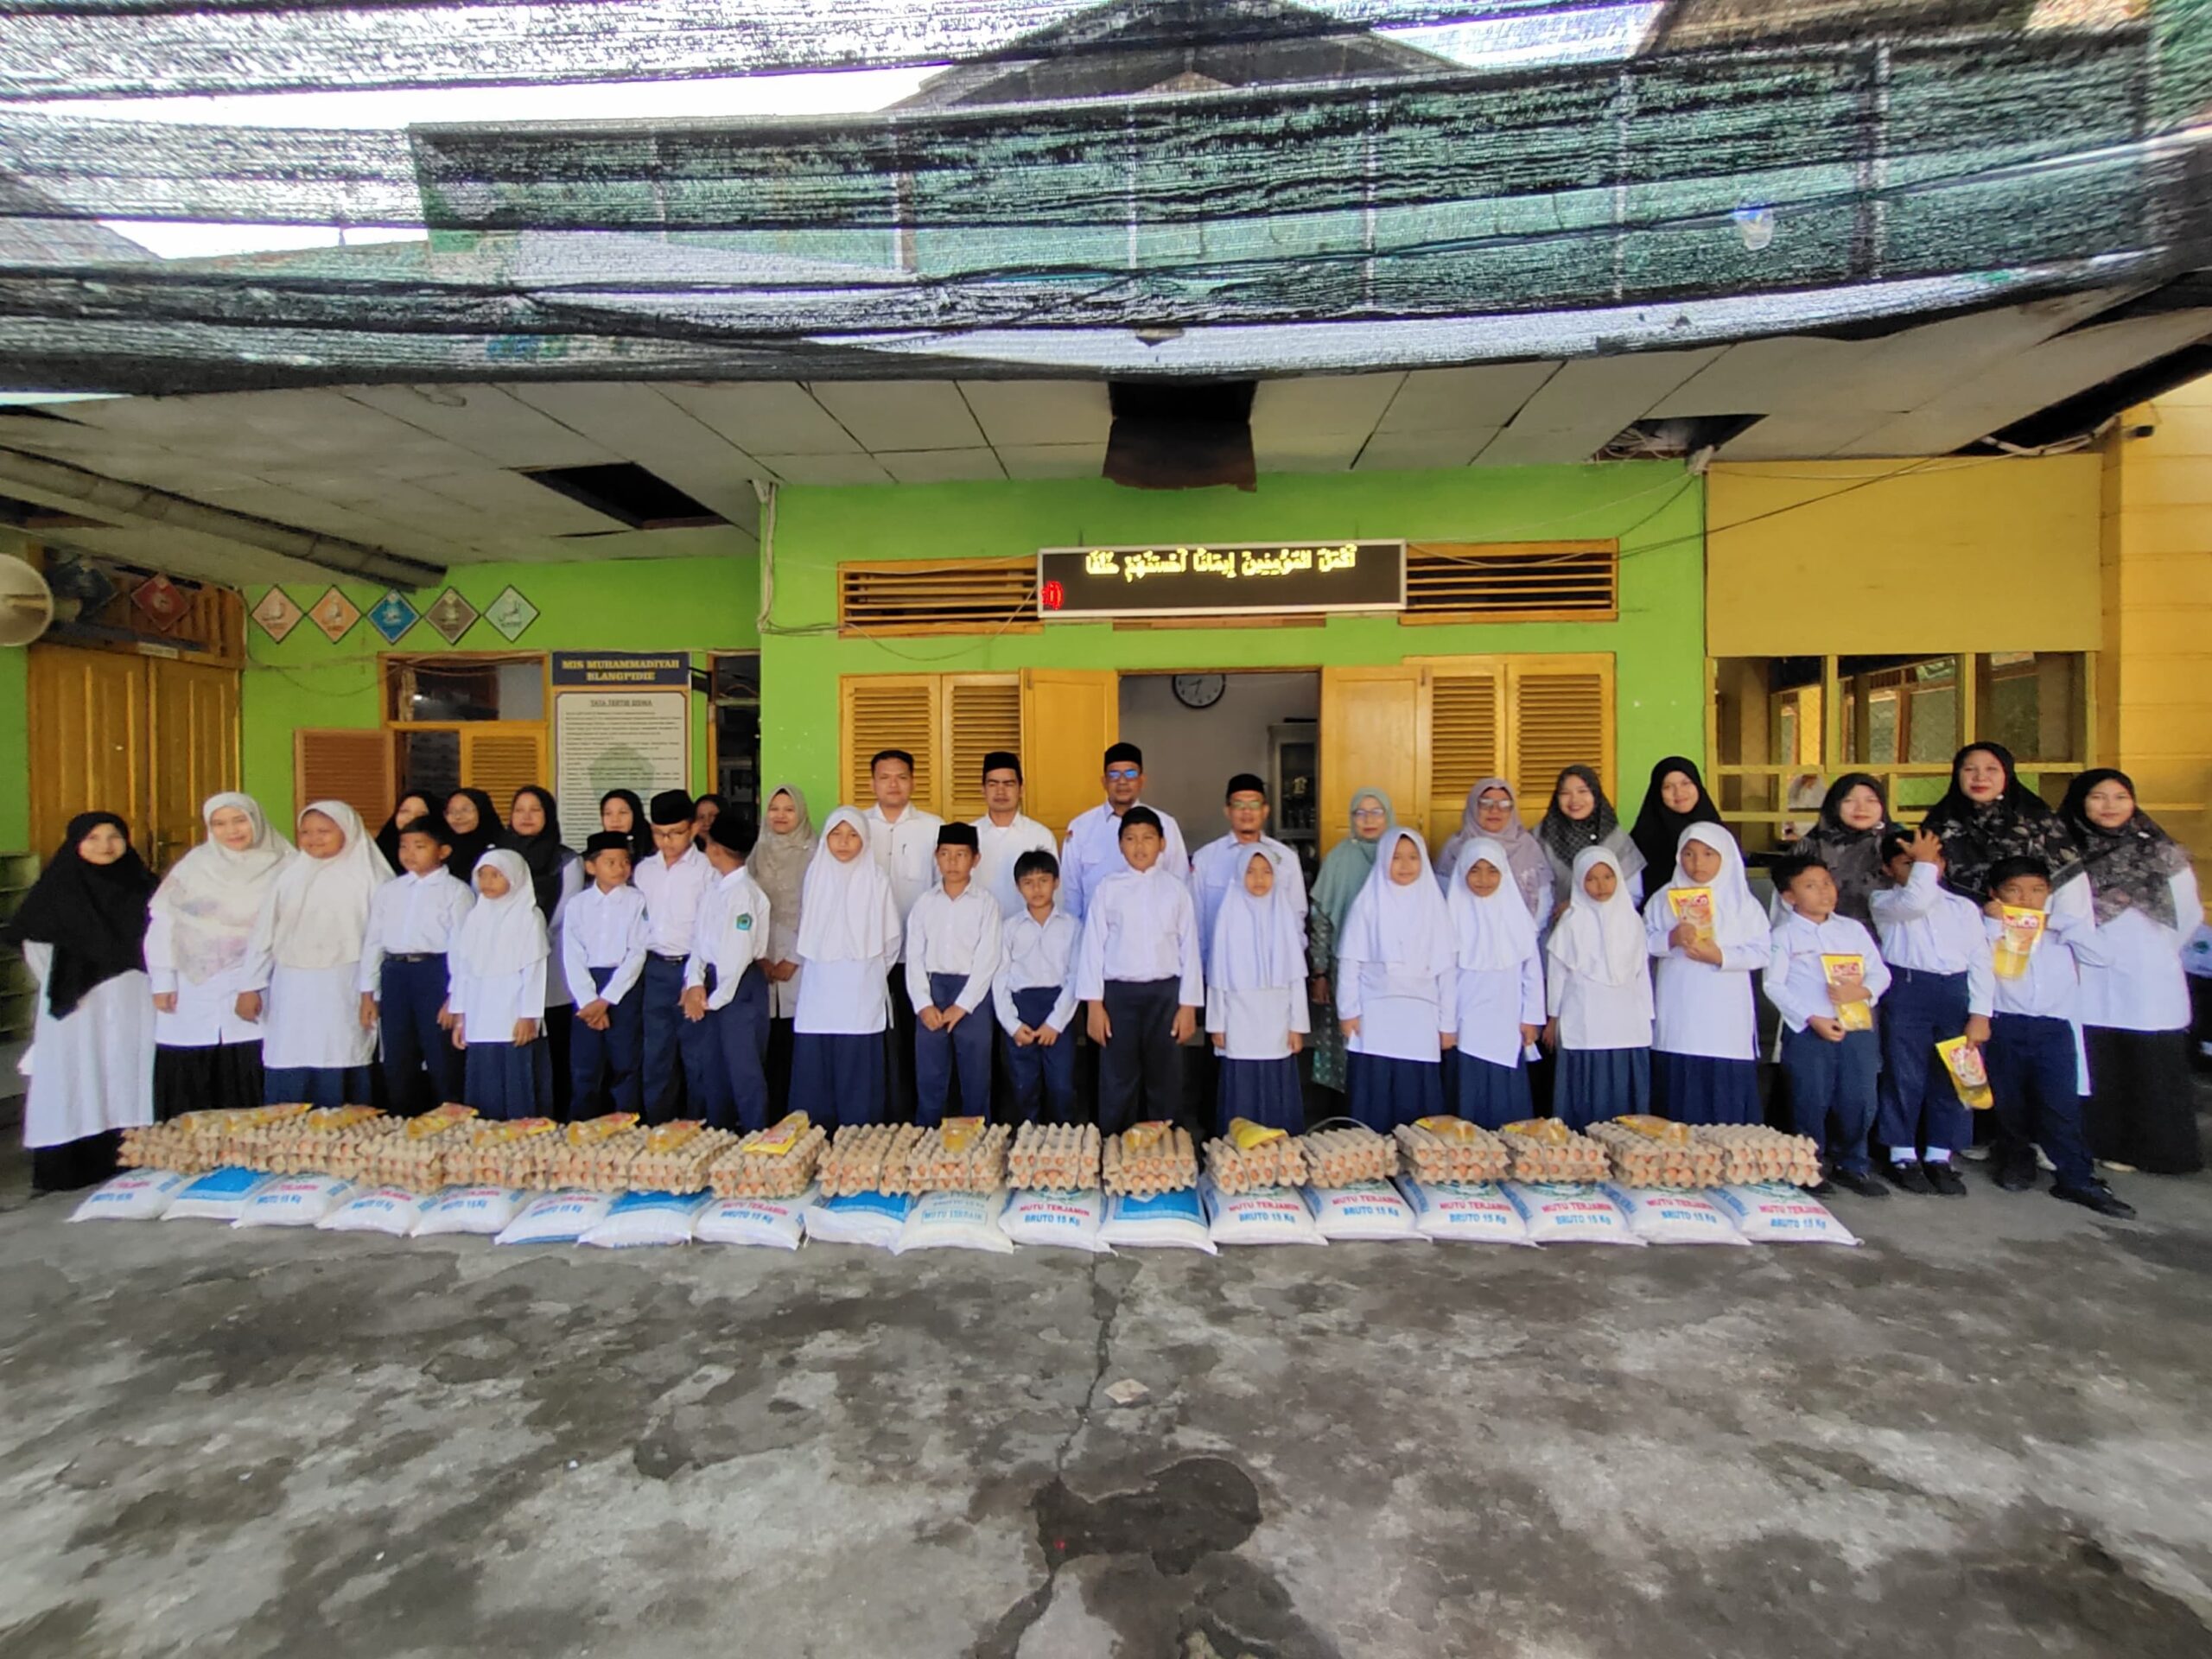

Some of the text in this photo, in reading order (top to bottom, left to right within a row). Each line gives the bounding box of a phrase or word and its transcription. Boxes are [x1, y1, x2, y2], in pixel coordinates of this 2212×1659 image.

[587, 659, 679, 670] MUHAMMADIYAH
[1046, 1204, 1090, 1216] TERJAMIN
[1257, 1200, 1300, 1211] TERJAMIN
[1468, 1201, 1511, 1211] TERJAMIN
[1344, 1206, 1373, 1216] BRUTO
[1024, 1214, 1054, 1223] BRUTO
[1239, 1212, 1268, 1222] BRUTO
[1449, 1213, 1480, 1223] BRUTO
